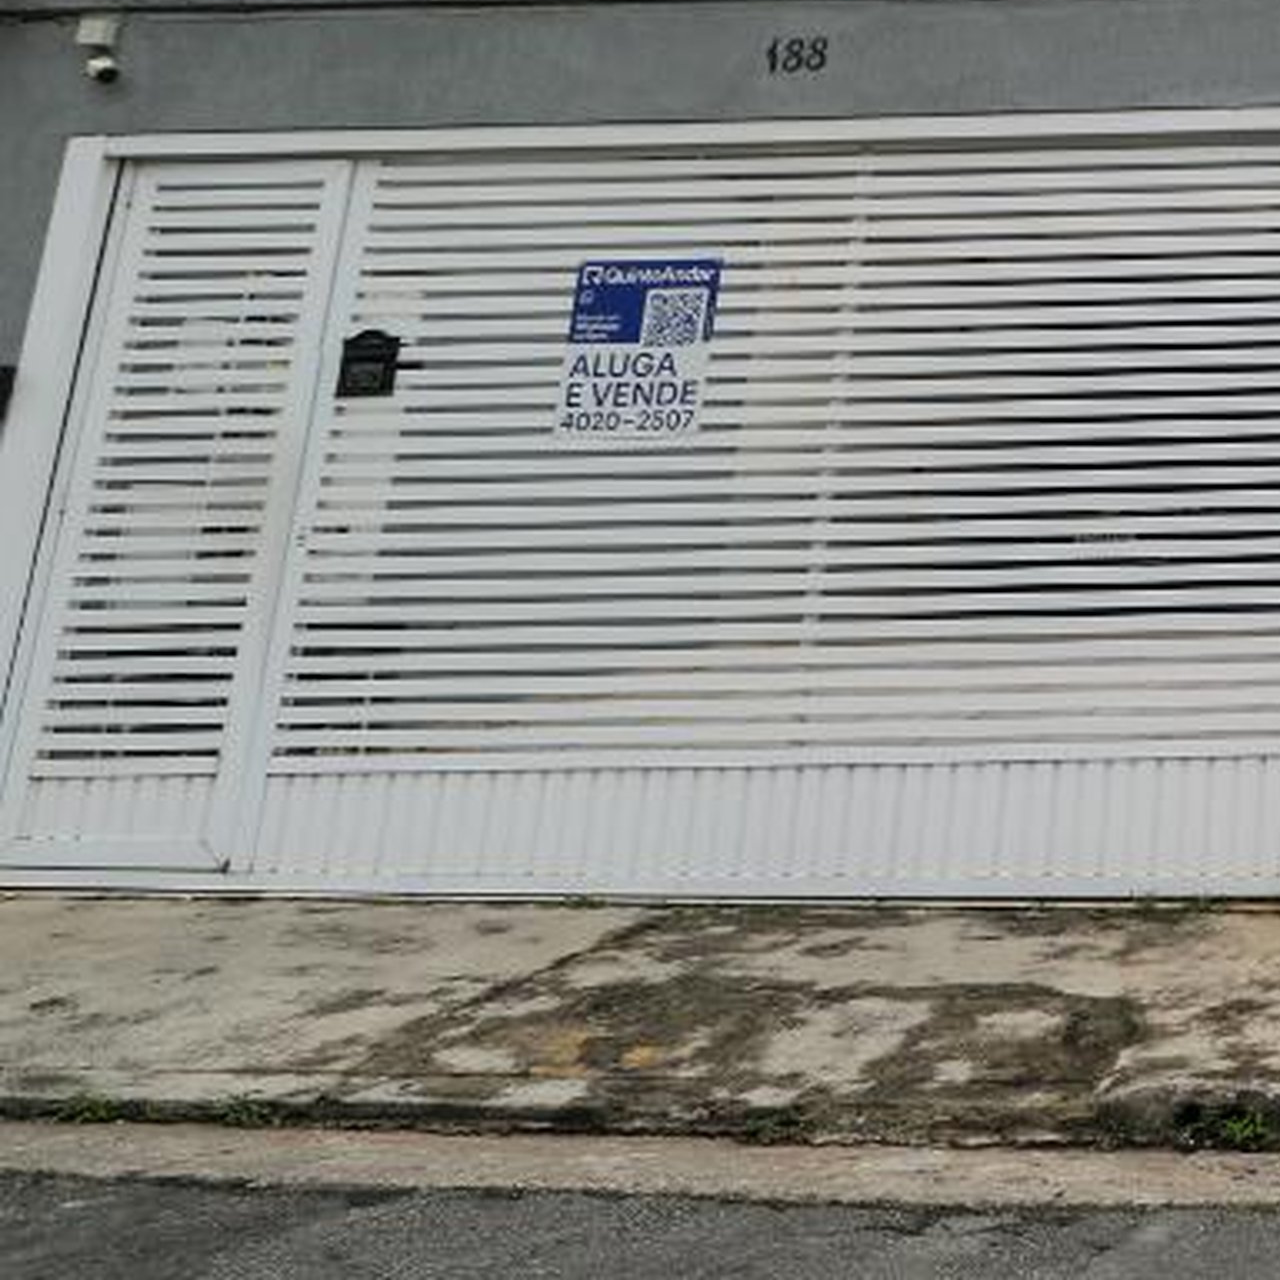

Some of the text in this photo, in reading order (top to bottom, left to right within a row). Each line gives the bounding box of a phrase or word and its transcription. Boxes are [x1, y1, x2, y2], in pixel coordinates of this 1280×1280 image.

[767, 36, 828, 74] 188
[568, 352, 677, 378] ALUGA
[565, 380, 699, 408] E VENDE
[560, 409, 695, 432] 4020-2507
